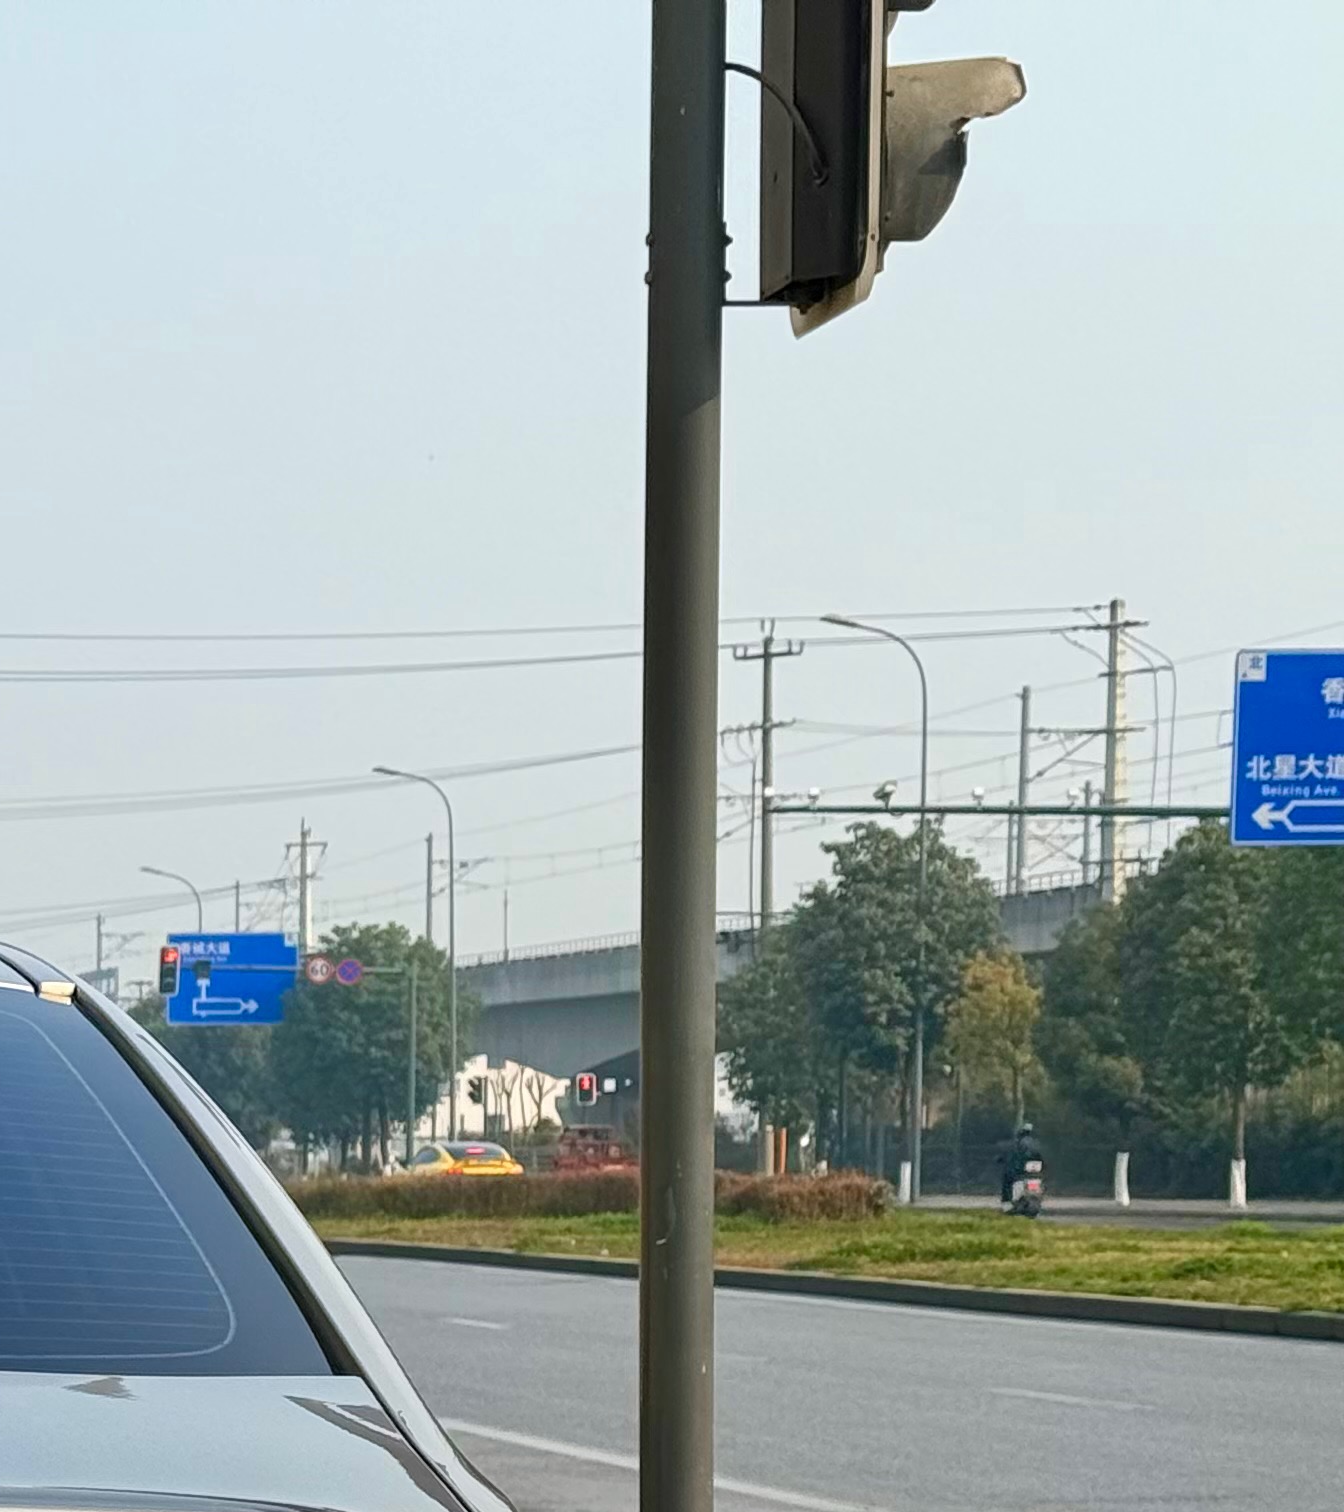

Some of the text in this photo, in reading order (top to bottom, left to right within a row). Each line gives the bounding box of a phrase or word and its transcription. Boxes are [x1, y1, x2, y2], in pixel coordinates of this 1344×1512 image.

[1245, 753, 1344, 781] 北星大道
[1262, 783, 1310, 798] Beixing
[311, 963, 329, 976] 60
